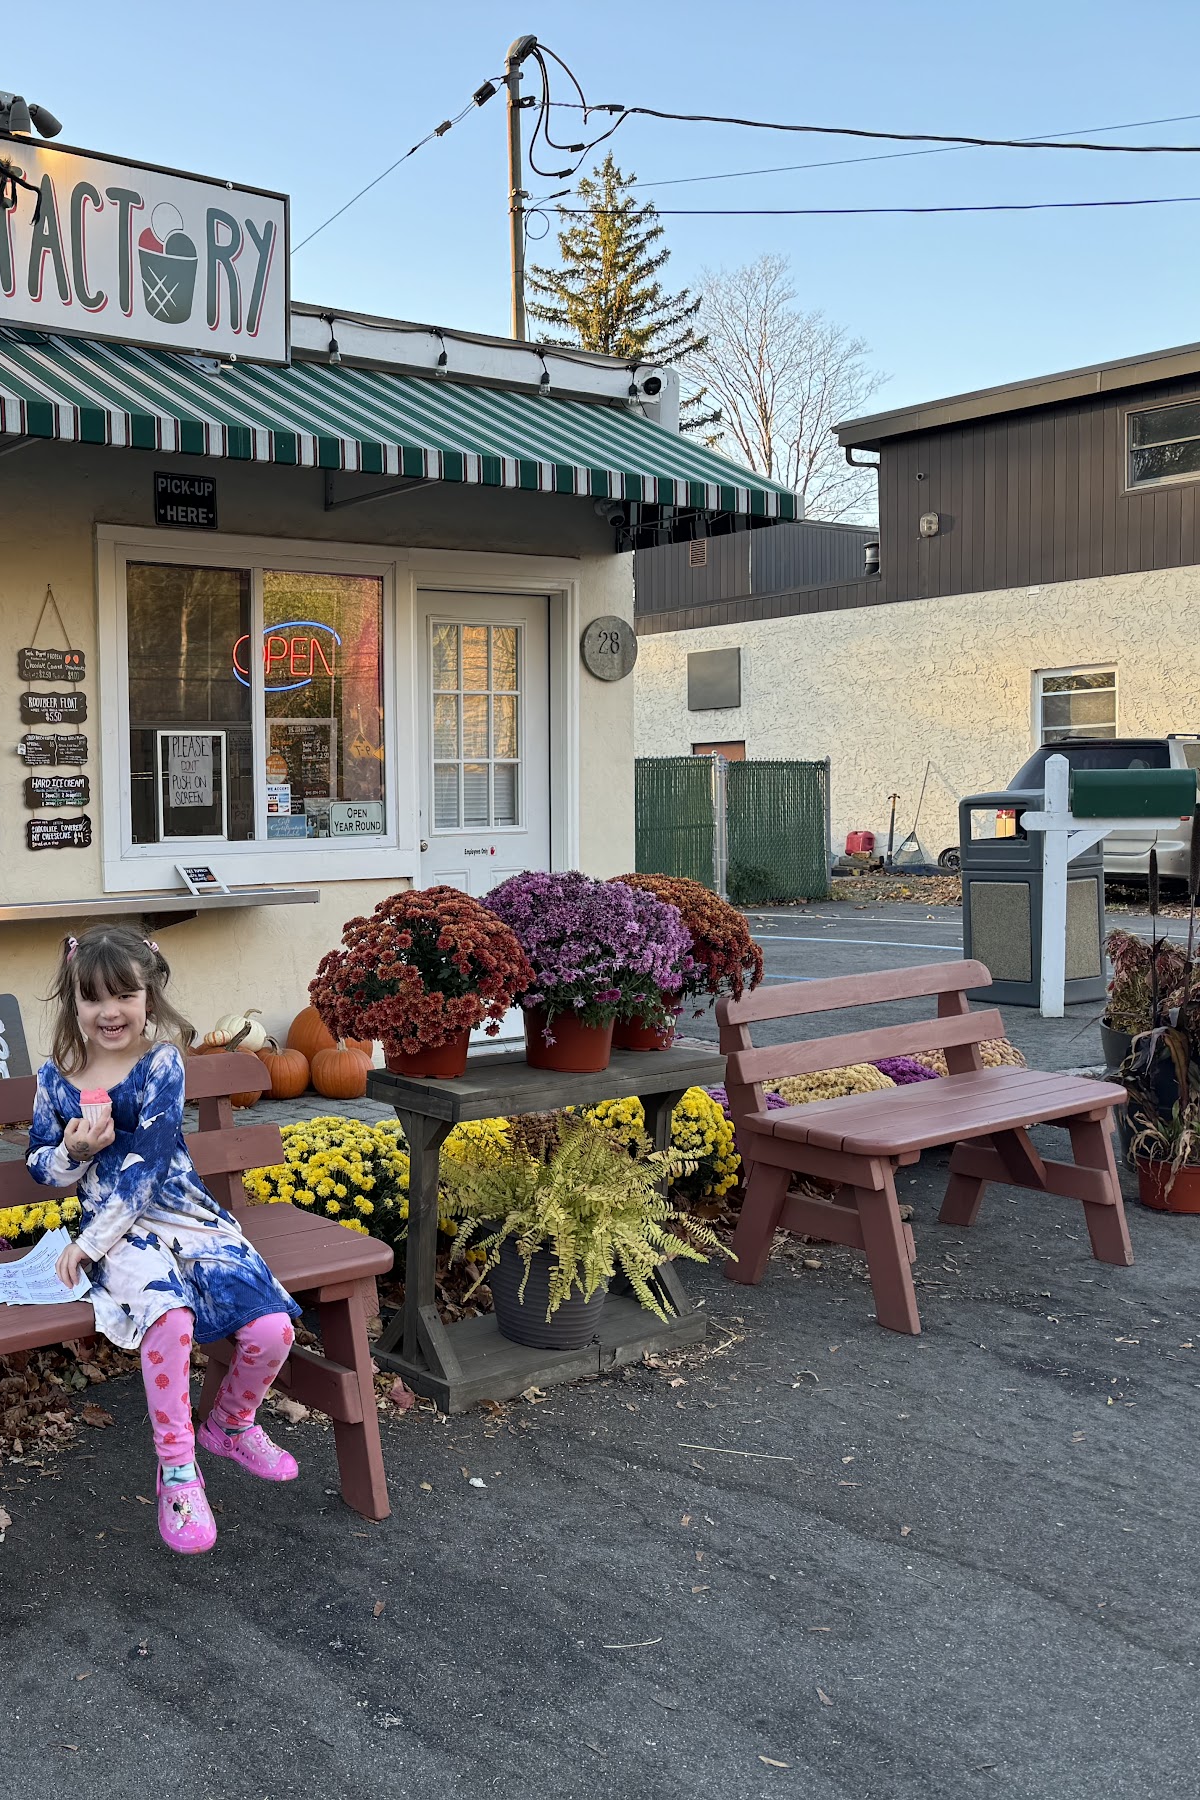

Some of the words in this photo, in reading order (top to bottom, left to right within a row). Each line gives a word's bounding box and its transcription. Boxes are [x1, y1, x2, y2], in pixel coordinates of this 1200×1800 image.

[158, 478, 213, 496] PICK-UP
[166, 505, 208, 524] HERE
[598, 630, 620, 654] 28
[232, 634, 334, 676] OPEN
[28, 697, 58, 708] ROOTBEER
[60, 697, 77, 709] FLOAT
[172, 736, 209, 758] PLEASE
[32, 779, 50, 788] HARD
[52, 779, 64, 787] ICE
[64, 779, 84, 788] CREAM
[172, 775, 192, 790] PUSH
[195, 776, 207, 788] ON
[175, 791, 203, 805] SCREEN
[74, 831, 84, 844] $4
